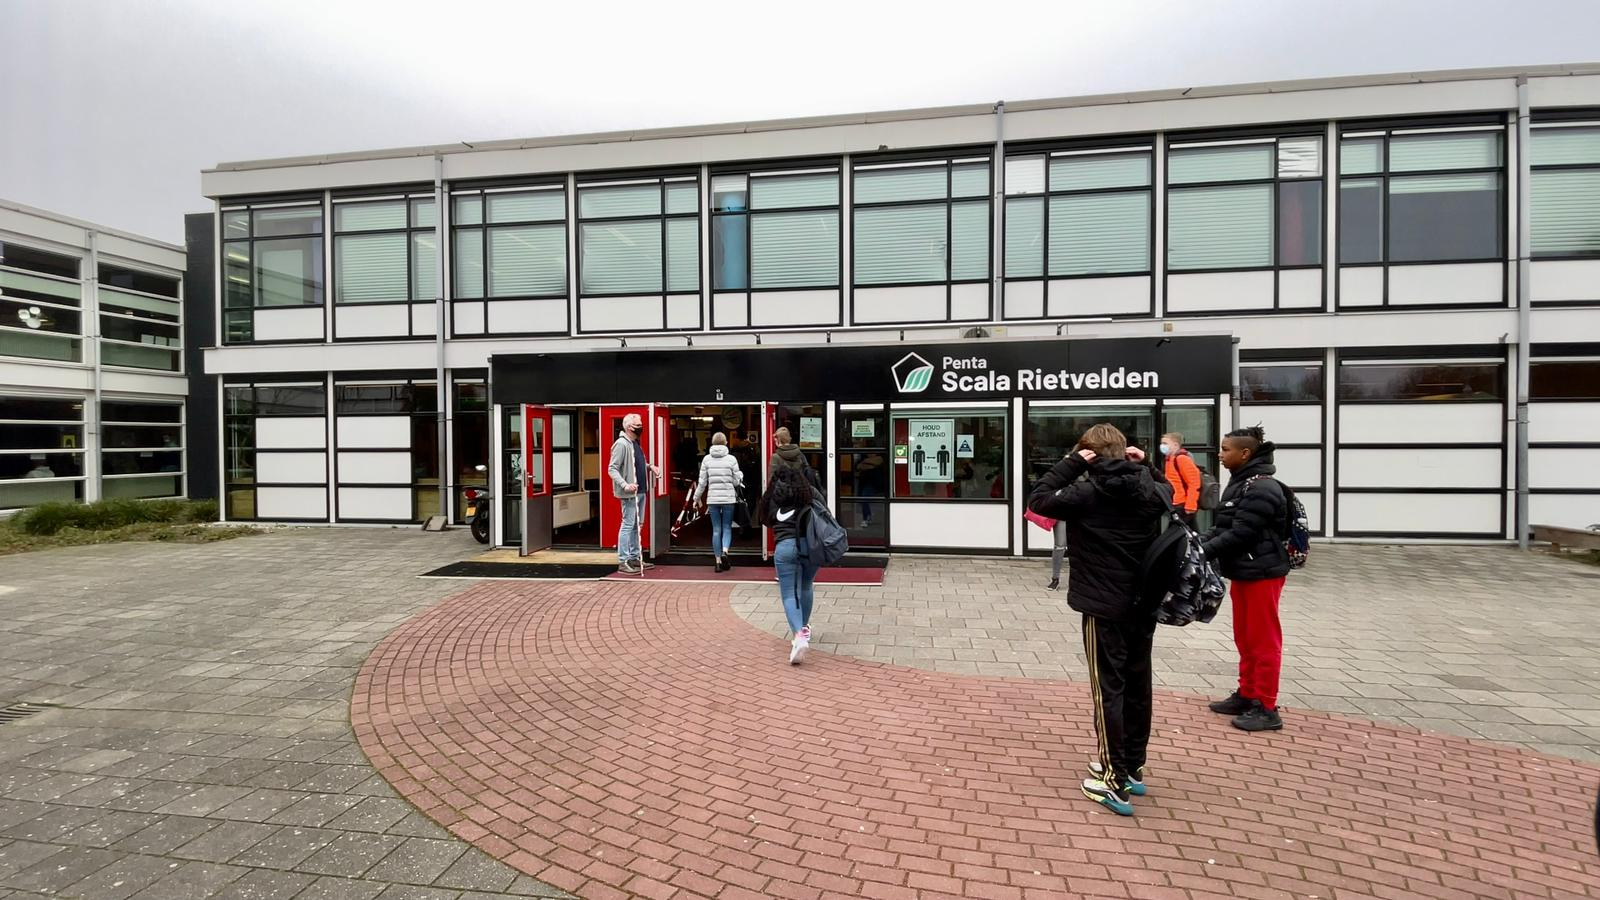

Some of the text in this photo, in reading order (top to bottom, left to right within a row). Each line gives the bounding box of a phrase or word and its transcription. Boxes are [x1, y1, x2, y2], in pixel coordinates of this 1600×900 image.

[942, 356, 987, 370] Penta
[942, 367, 1159, 392] Scala Rietvelden
